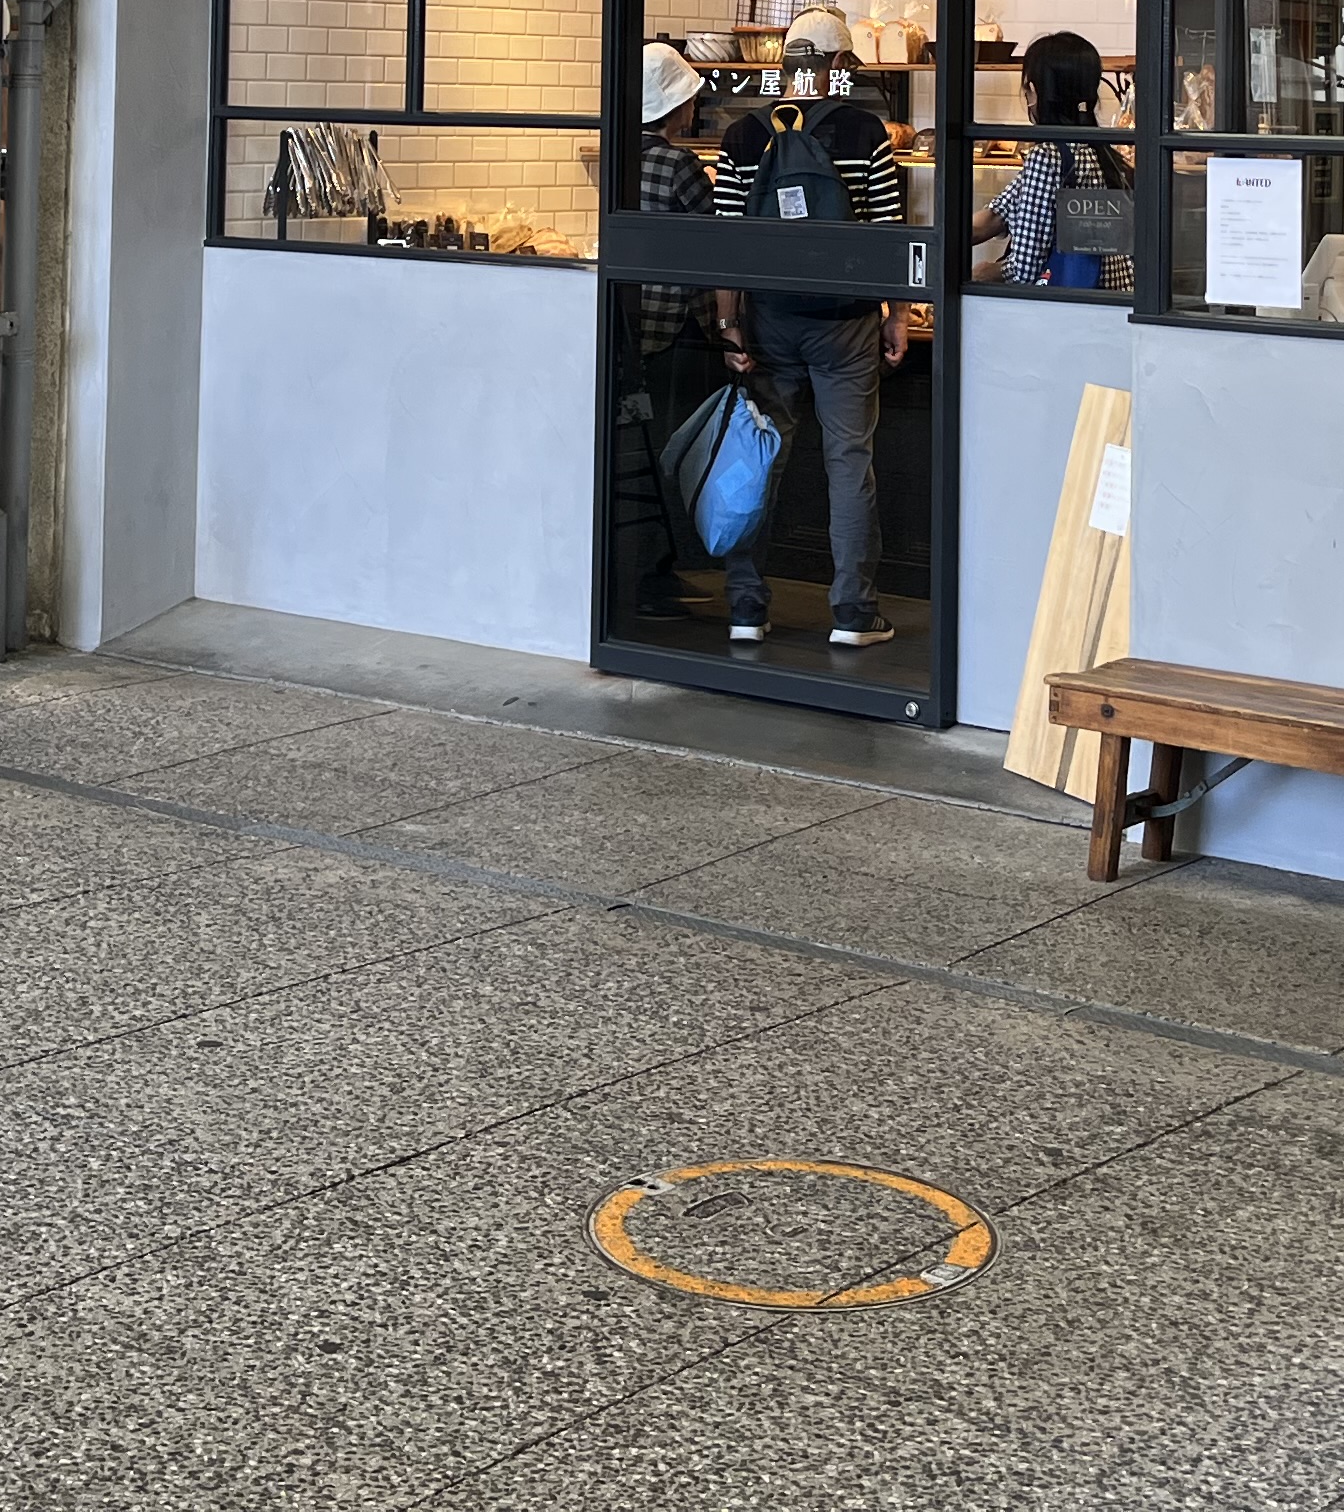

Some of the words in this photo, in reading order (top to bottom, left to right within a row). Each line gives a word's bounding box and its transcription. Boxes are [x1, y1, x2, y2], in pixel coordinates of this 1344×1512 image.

[696, 68, 854, 96] パン屋航路
[1067, 199, 1121, 215] OPEN
